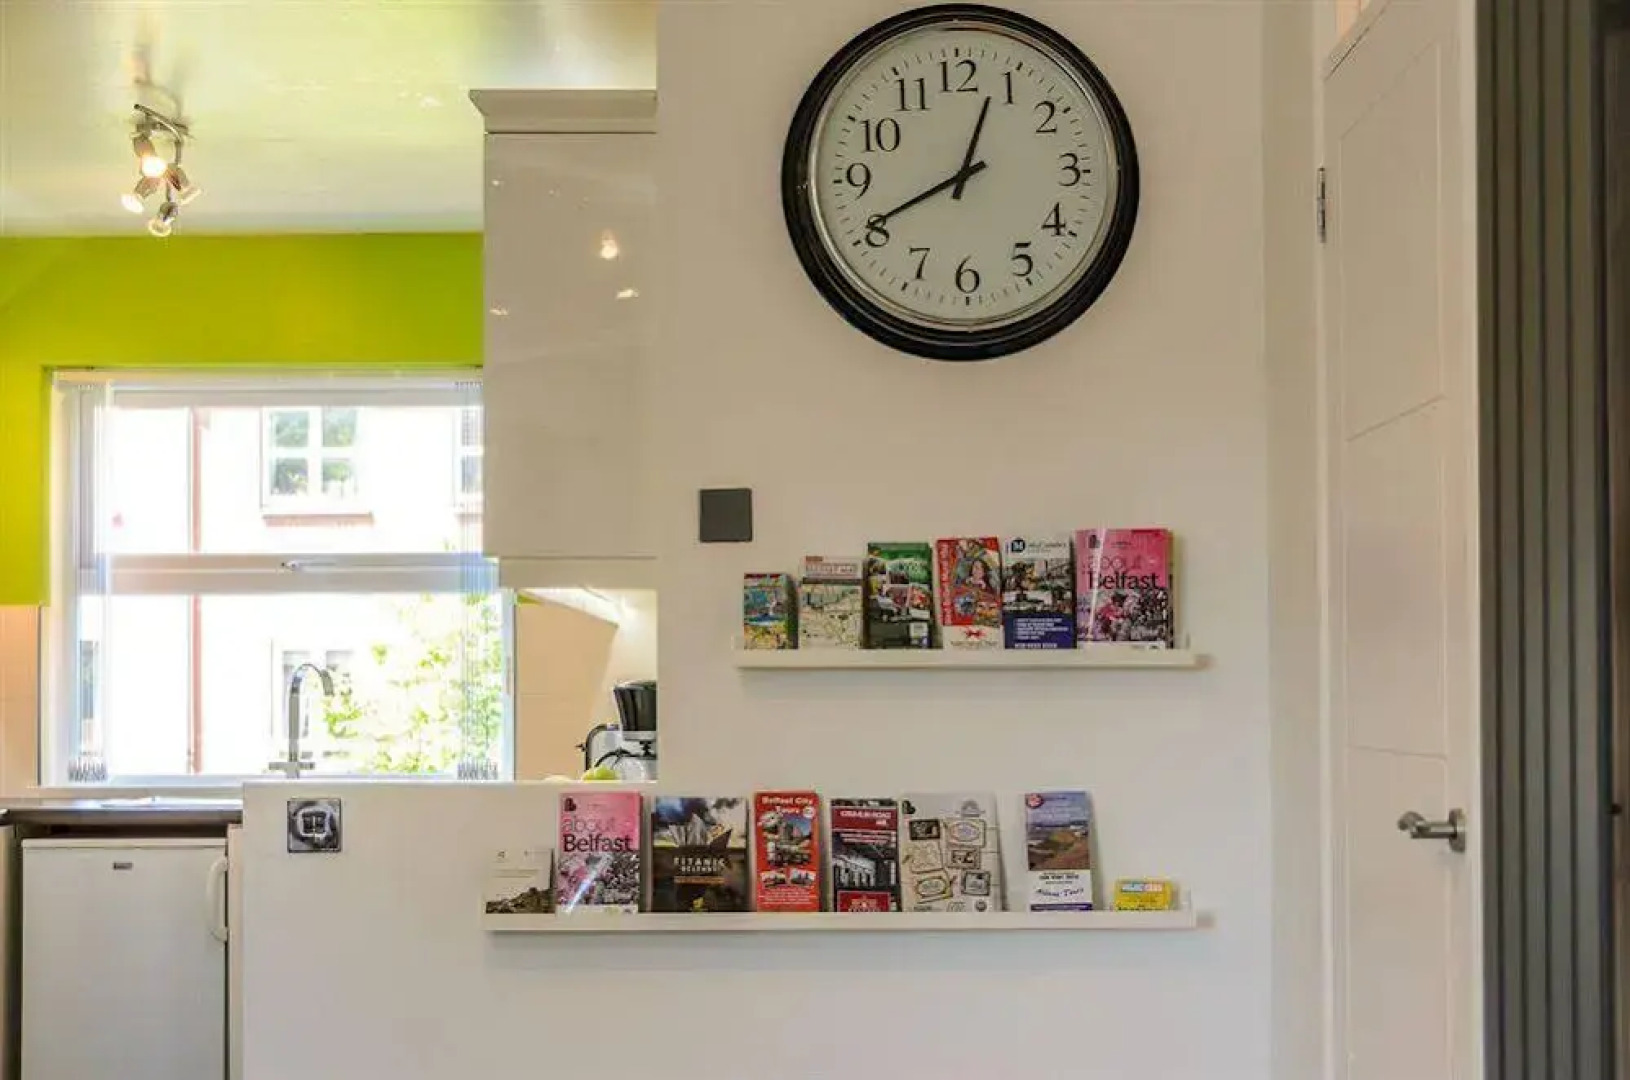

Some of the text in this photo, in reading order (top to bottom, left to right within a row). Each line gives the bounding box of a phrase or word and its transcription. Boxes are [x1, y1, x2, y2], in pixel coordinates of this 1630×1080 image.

[940, 60, 978, 92] 12
[1002, 71, 1013, 104] 1
[896, 77, 931, 112] 11
[1034, 101, 1057, 133] 2
[861, 118, 900, 152] 10
[846, 162, 871, 200] 9
[1058, 153, 1081, 186] 3
[866, 214, 890, 247] 8
[1041, 202, 1066, 236] 4
[909, 247, 931, 280] 7
[955, 255, 980, 293] 6
[1012, 242, 1034, 276] 5
[1088, 571, 1160, 590] Belfast
[562, 815, 616, 833] about
[563, 833, 634, 852] Belfast
